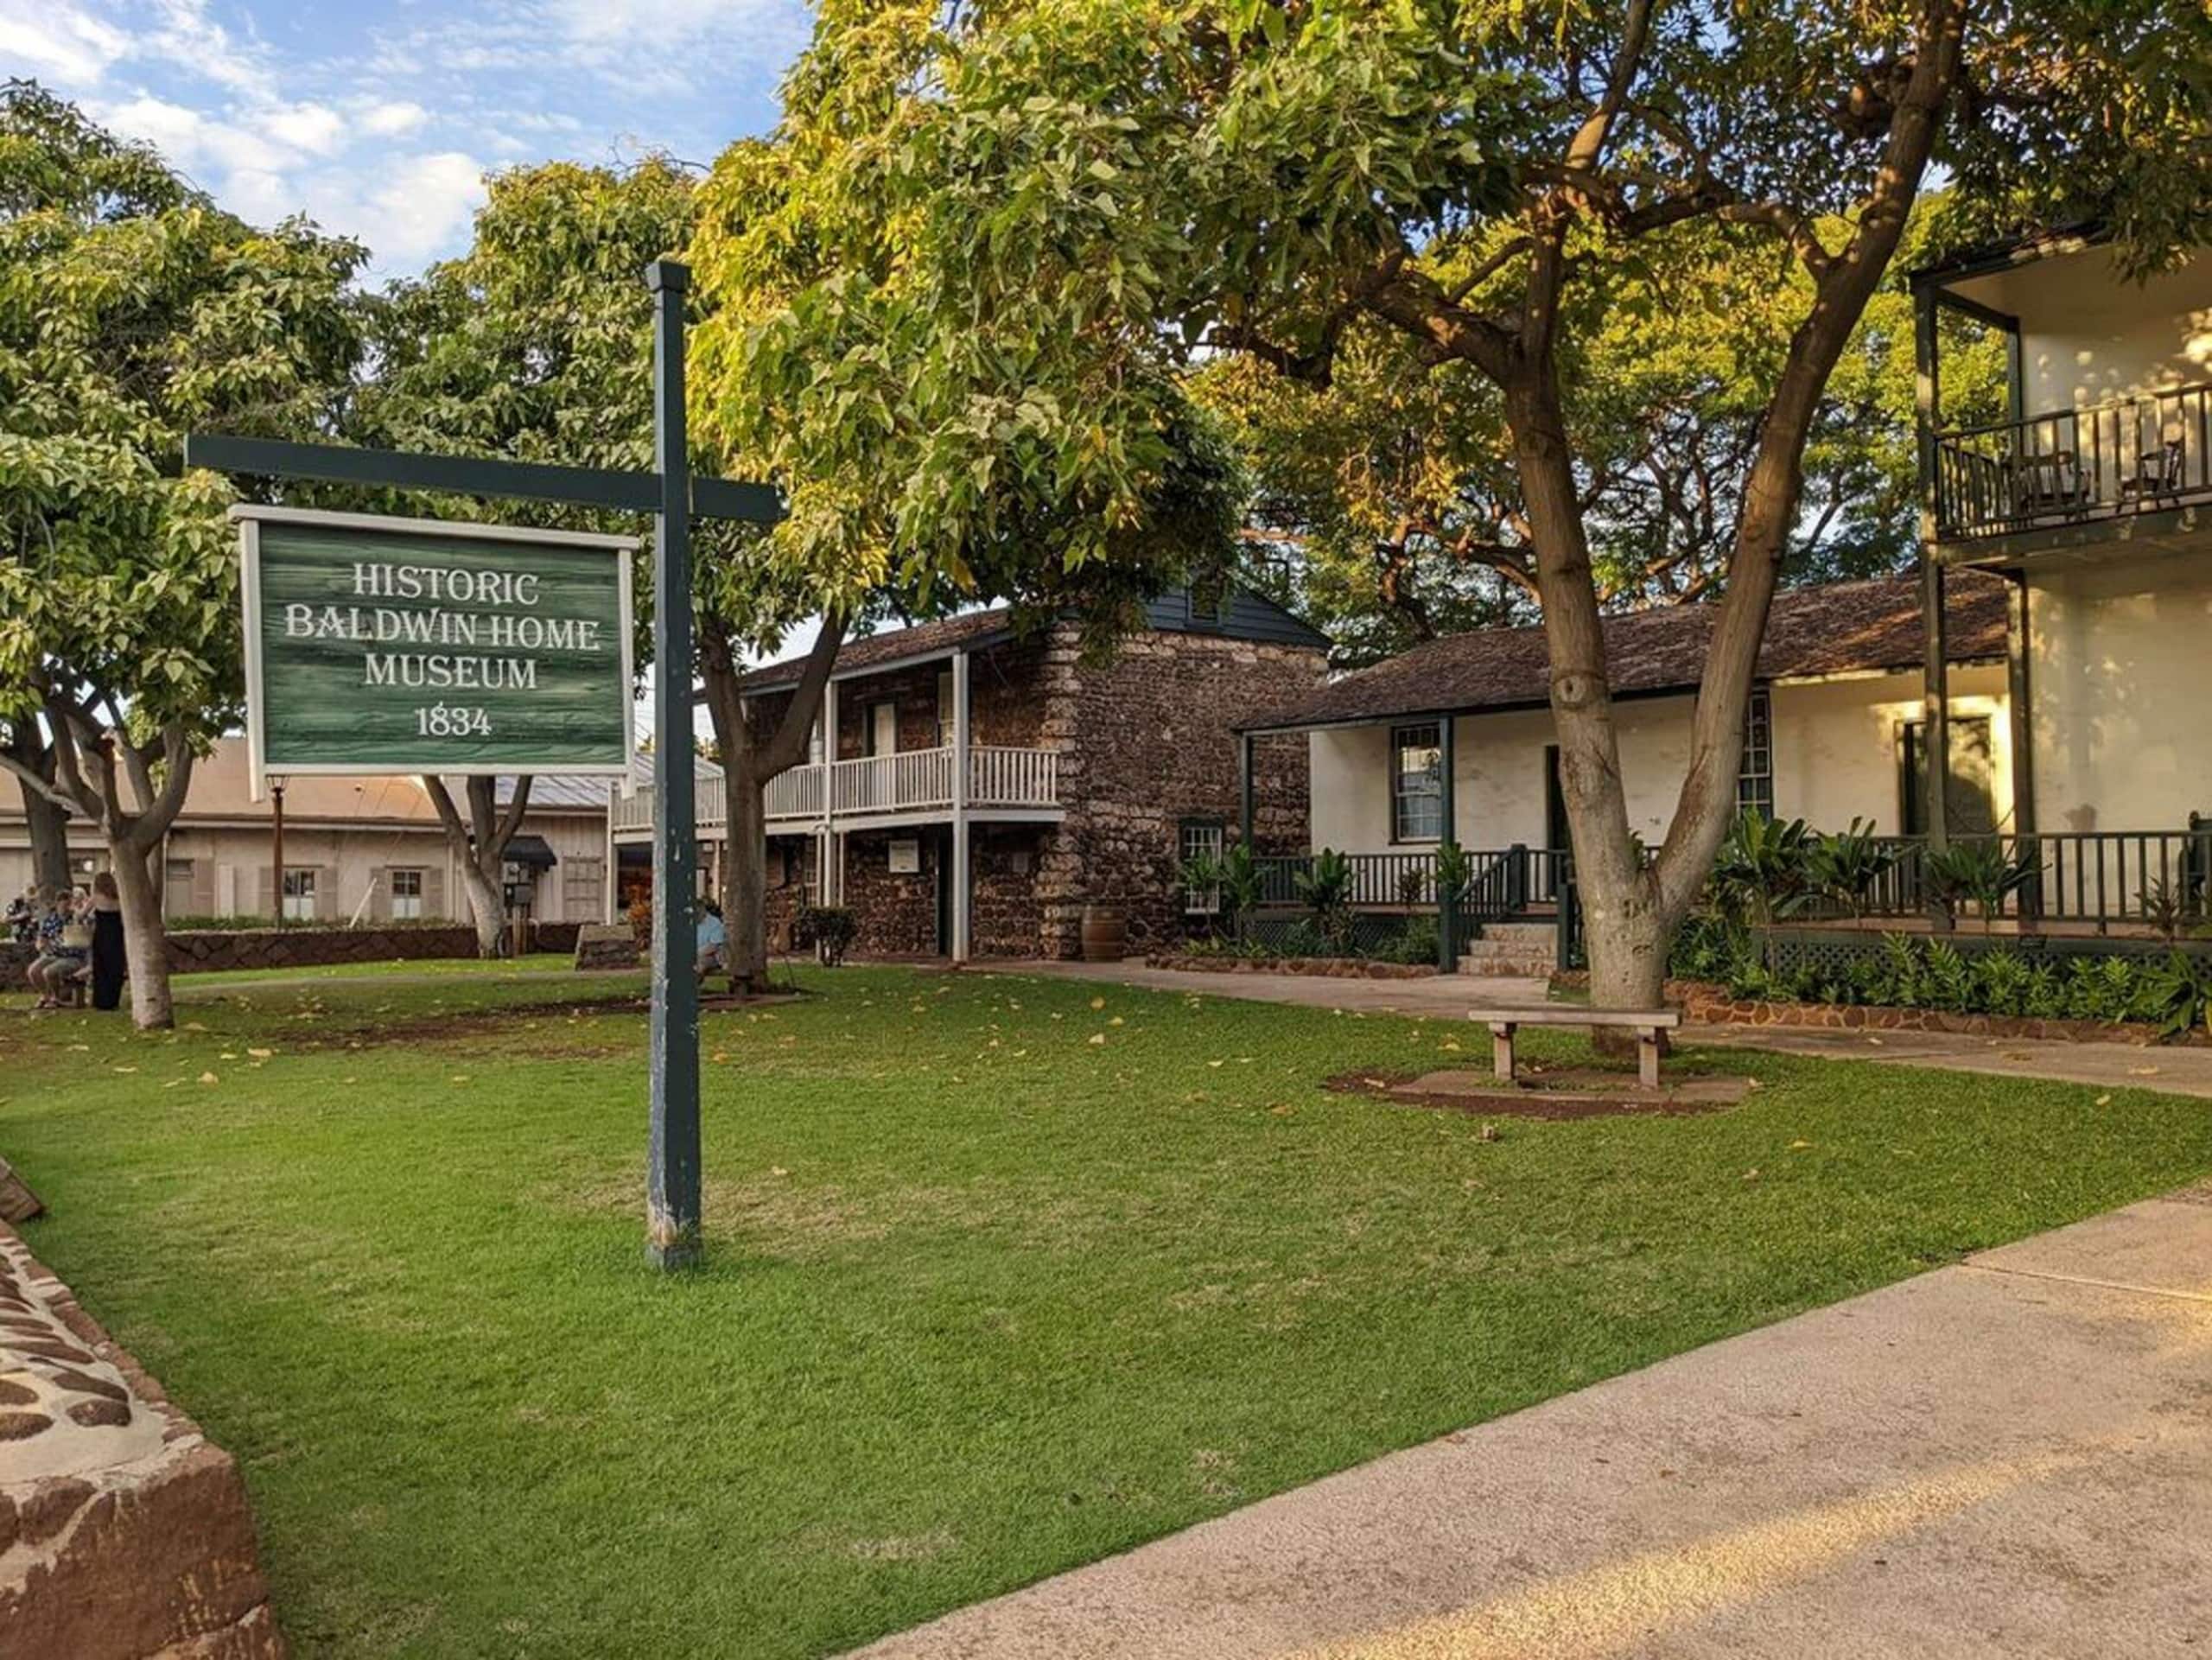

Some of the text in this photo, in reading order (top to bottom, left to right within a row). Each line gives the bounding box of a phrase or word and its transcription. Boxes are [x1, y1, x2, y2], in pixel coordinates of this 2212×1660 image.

[353, 563, 539, 606] HISTORIC
[284, 604, 601, 651] BALDWIN HOME
[365, 652, 537, 690] MUSEUM
[414, 701, 493, 736] 1834
